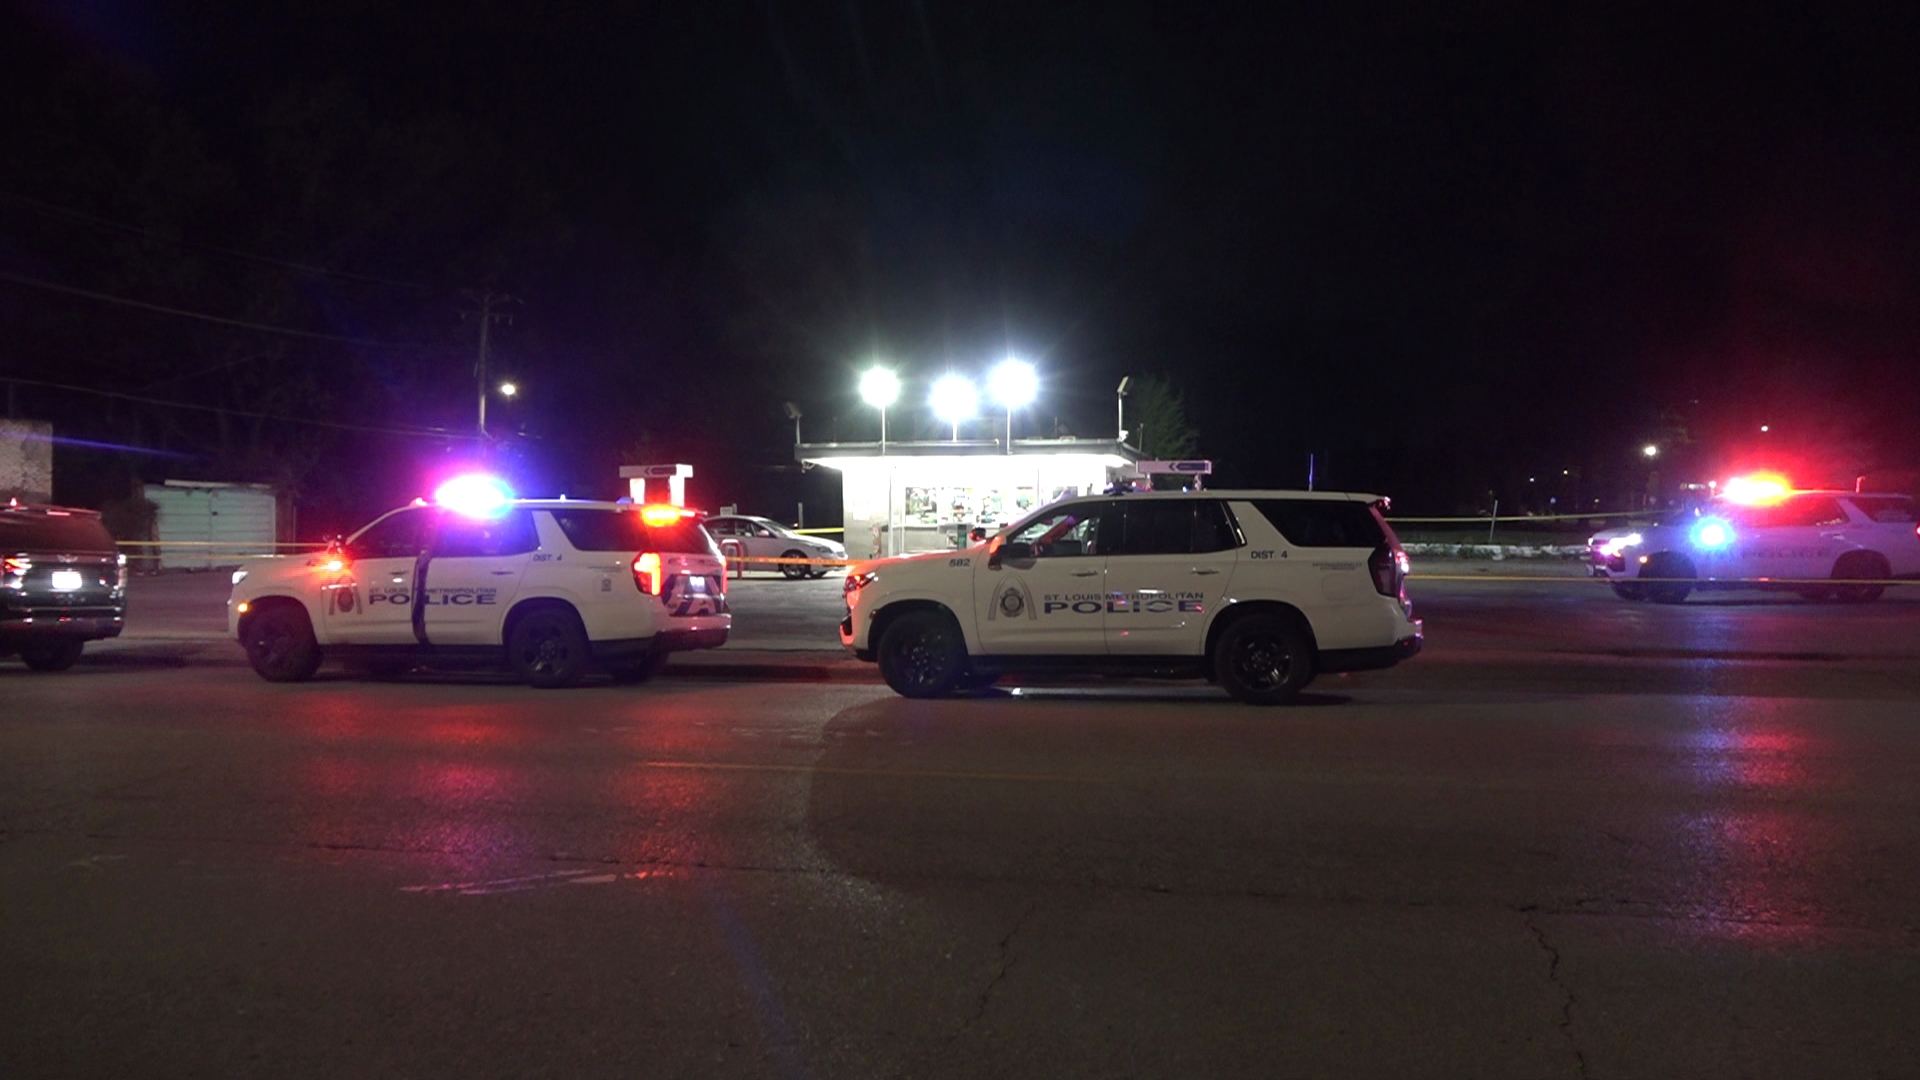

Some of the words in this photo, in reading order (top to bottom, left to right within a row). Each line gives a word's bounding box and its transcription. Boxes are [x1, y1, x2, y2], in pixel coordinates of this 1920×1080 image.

[1281, 551, 1288, 559] 4
[949, 558, 970, 567] 582
[369, 594, 497, 605] POLICE
[1065, 593, 1101, 601] LOUIS
[1105, 592, 1204, 601] METROPOLITAN
[1044, 601, 1203, 614] POLICE
